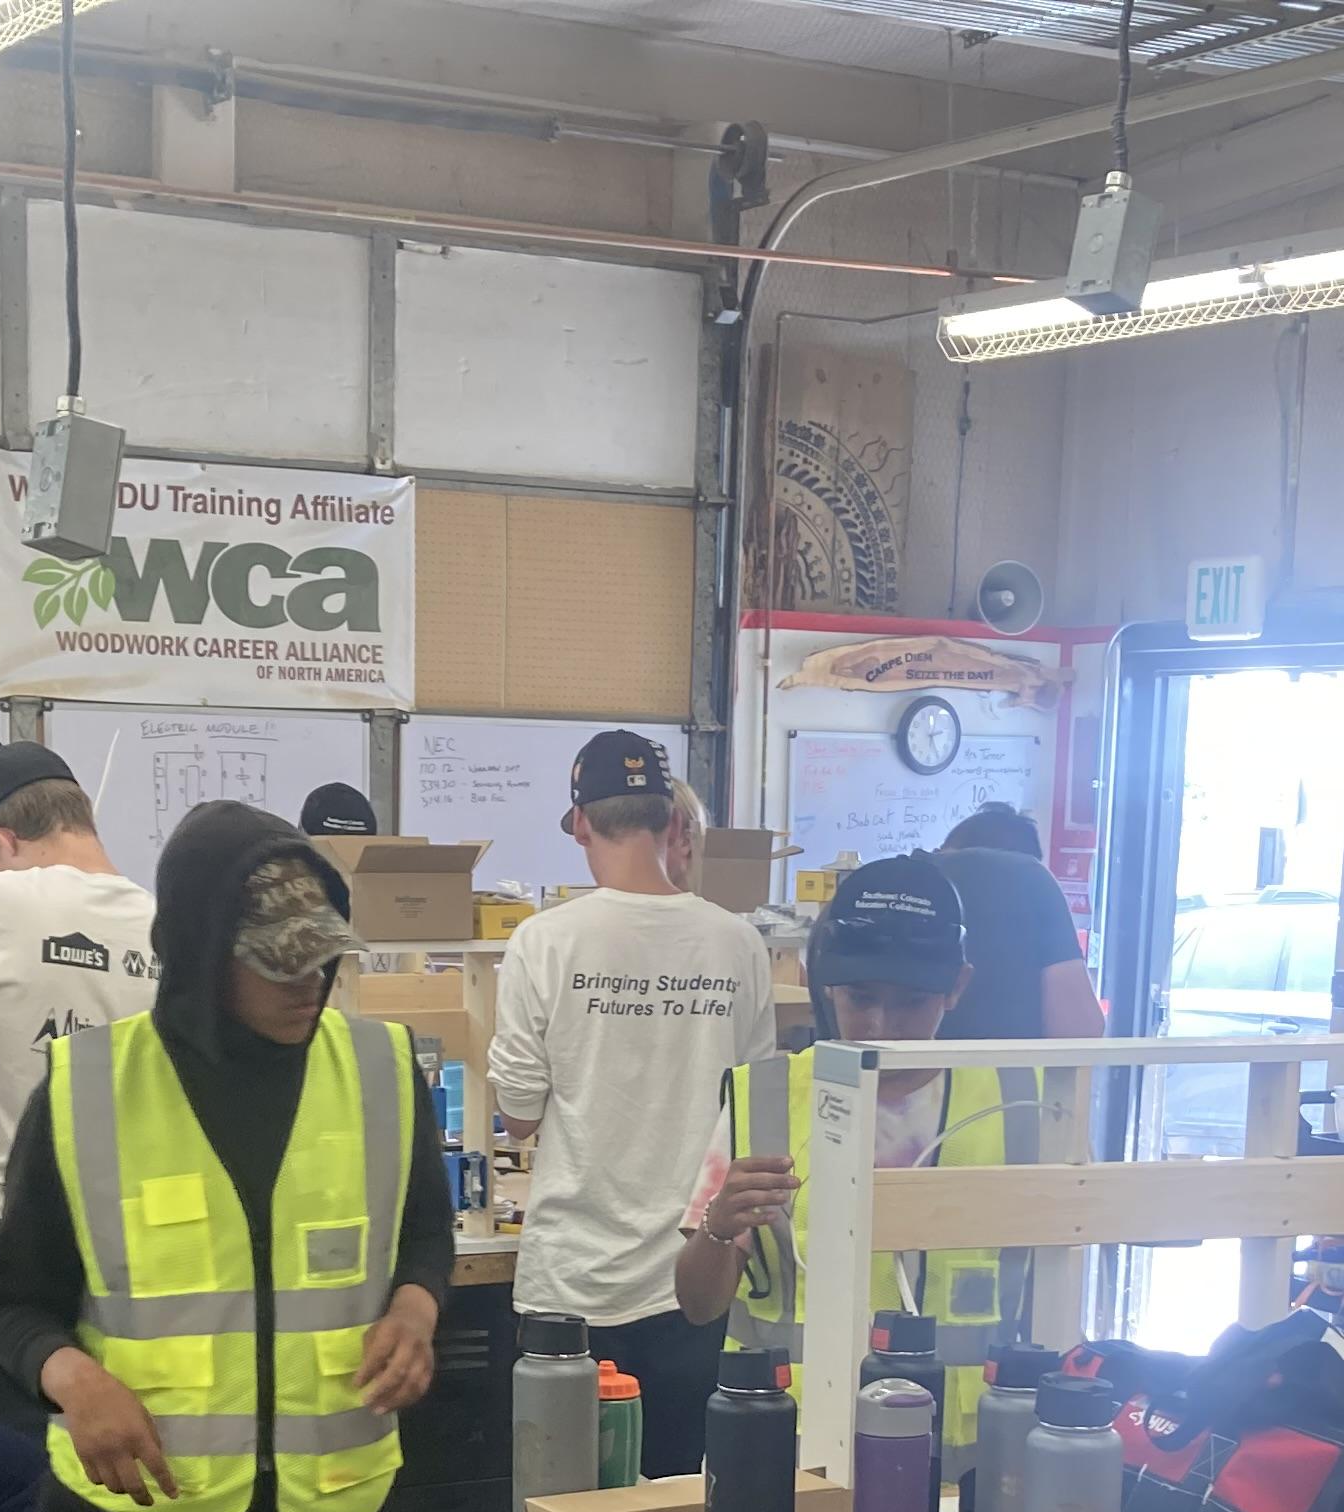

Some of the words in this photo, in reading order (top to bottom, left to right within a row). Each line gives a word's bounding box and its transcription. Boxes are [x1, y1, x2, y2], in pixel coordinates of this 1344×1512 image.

[118, 483, 160, 510] DU
[167, 485, 281, 525] Training
[290, 493, 395, 525] Affiliate
[102, 536, 382, 633] wca
[1195, 564, 1244, 625] EXIT
[56, 630, 189, 657] WOODWORK
[194, 637, 279, 661] CAREER
[285, 641, 383, 665] ALLIANCE
[256, 664, 273, 680] OF
[278, 666, 323, 682] NORTH
[325, 668, 385, 684] AMERICA
[865, 653, 904, 682] CARPE
[905, 651, 933, 664] DIEM
[906, 668, 939, 681] SEIZE
[943, 670, 964, 681] THE
[967, 669, 994, 681] DAY!
[423, 735, 457, 756] NEC
[49, 941, 105, 968] LOWE'S
[572, 972, 650, 996] Bringing
[586, 998, 655, 1018] Futures
[662, 1000, 685, 1017] To
[690, 998, 734, 1018] Life!
